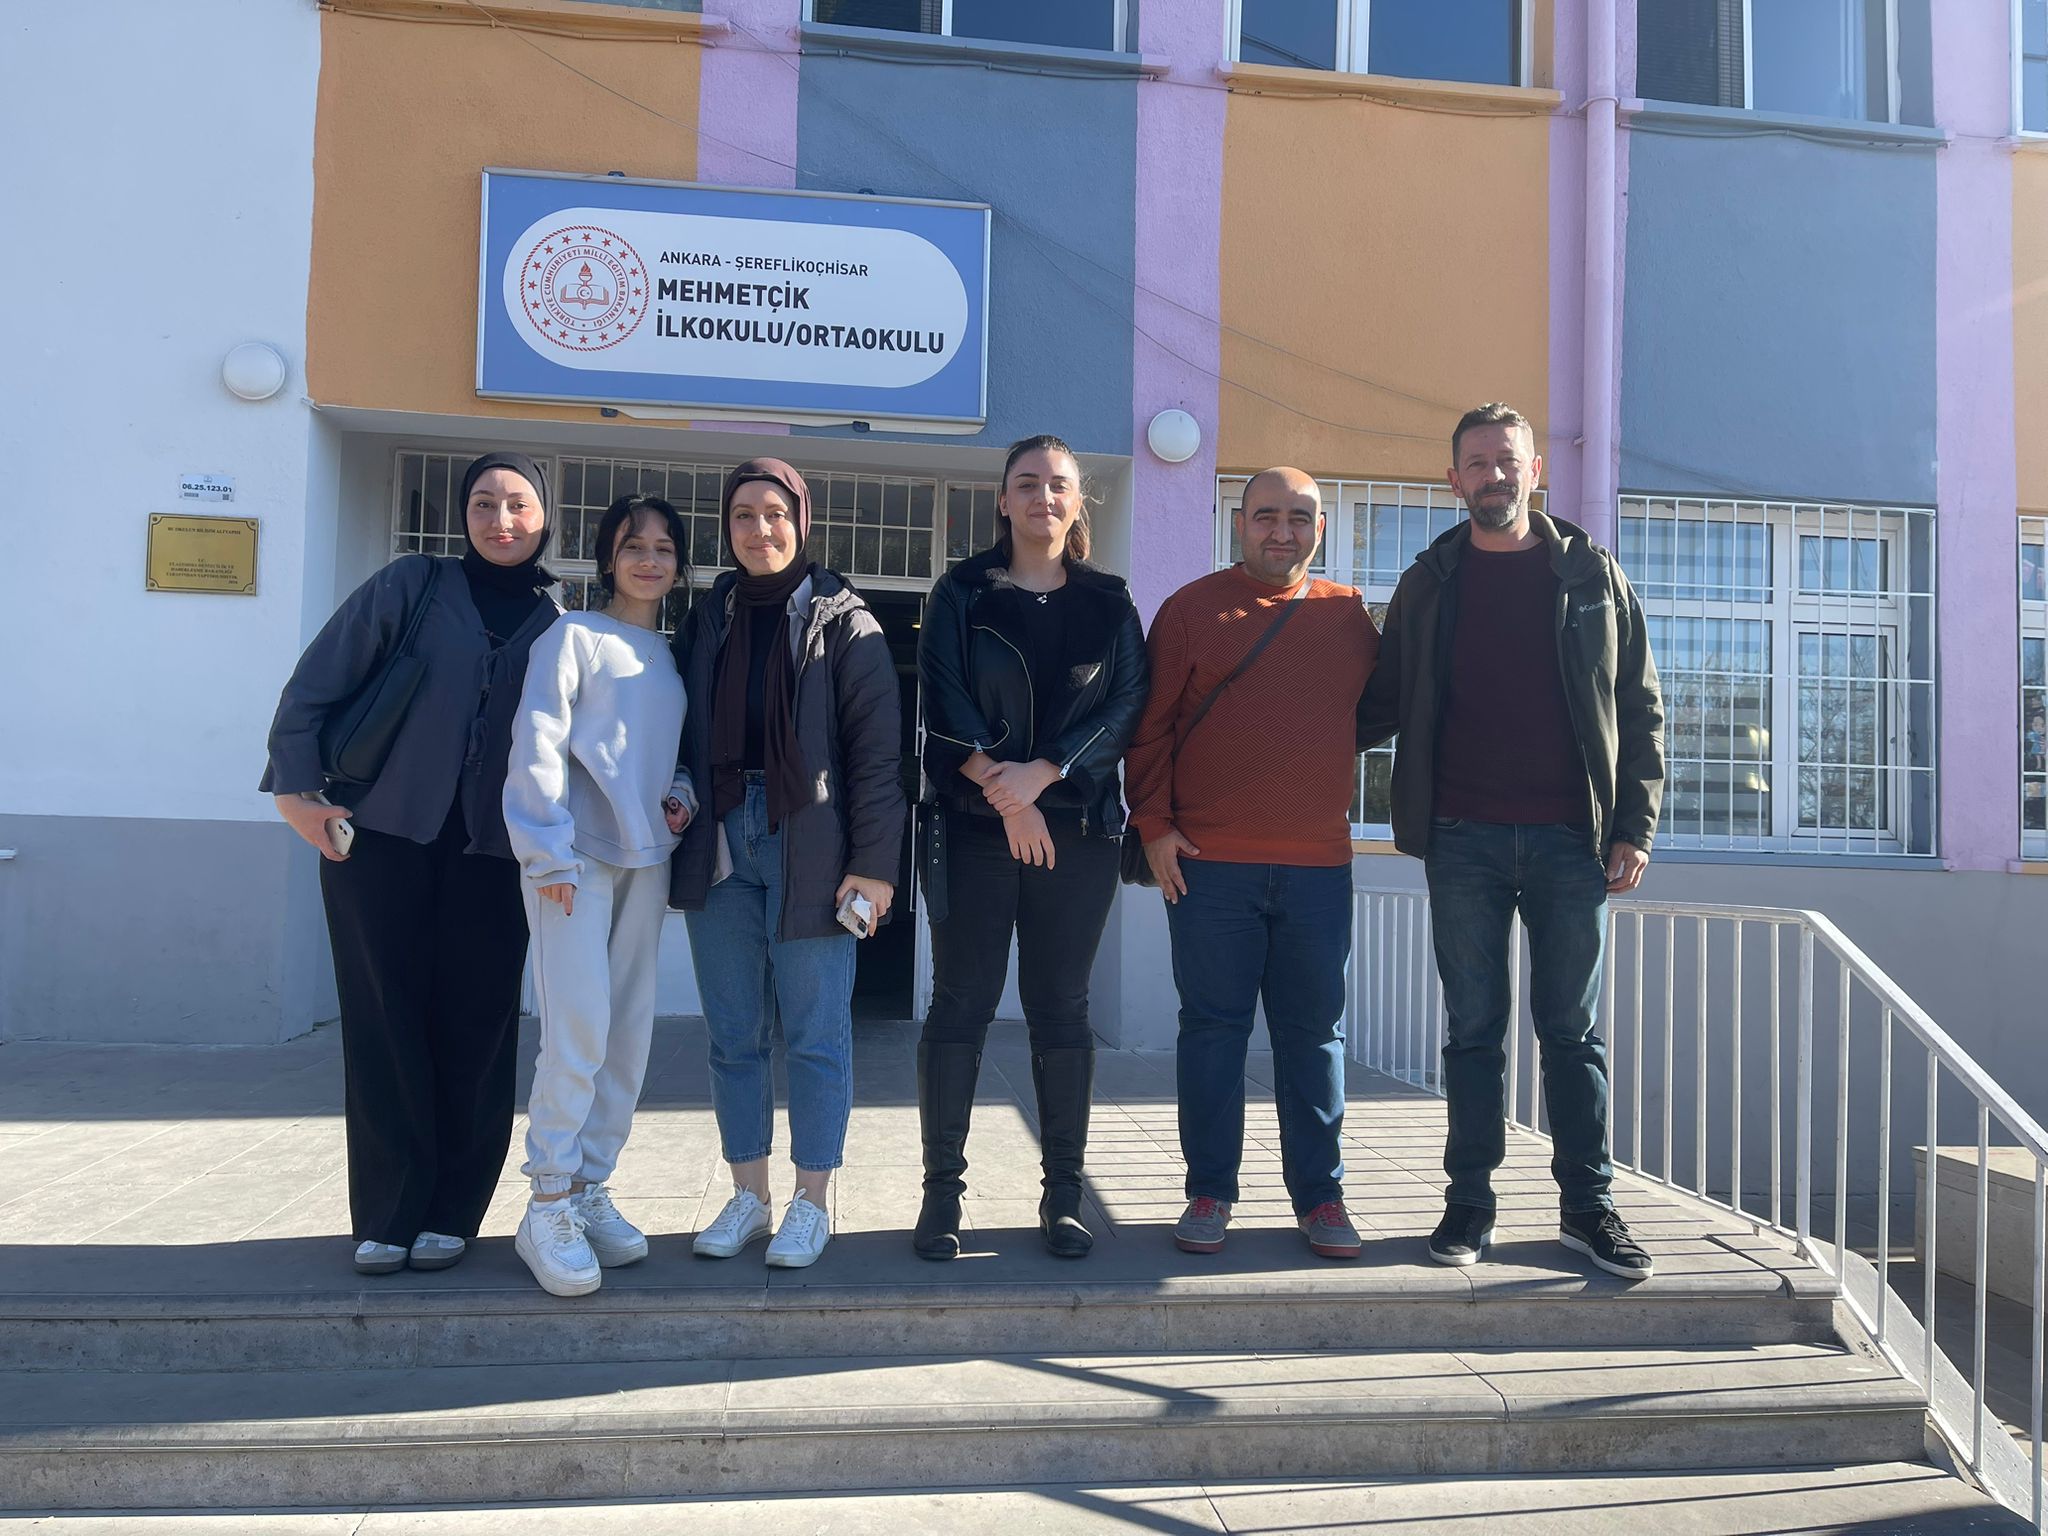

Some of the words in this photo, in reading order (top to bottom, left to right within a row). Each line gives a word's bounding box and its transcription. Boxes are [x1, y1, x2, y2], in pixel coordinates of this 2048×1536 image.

[544, 248, 581, 296] CUMHURİYETİ
[583, 248, 608, 261] MİLLİ
[607, 260, 626, 286] EĞİTİM
[659, 251, 721, 267] ANKARA
[735, 256, 868, 277] ŞEREFLİKOÇHİSAR
[657, 278, 810, 313] MEHMETÇİK
[656, 308, 945, 354] İLKOKULU/ORTAOKULU
